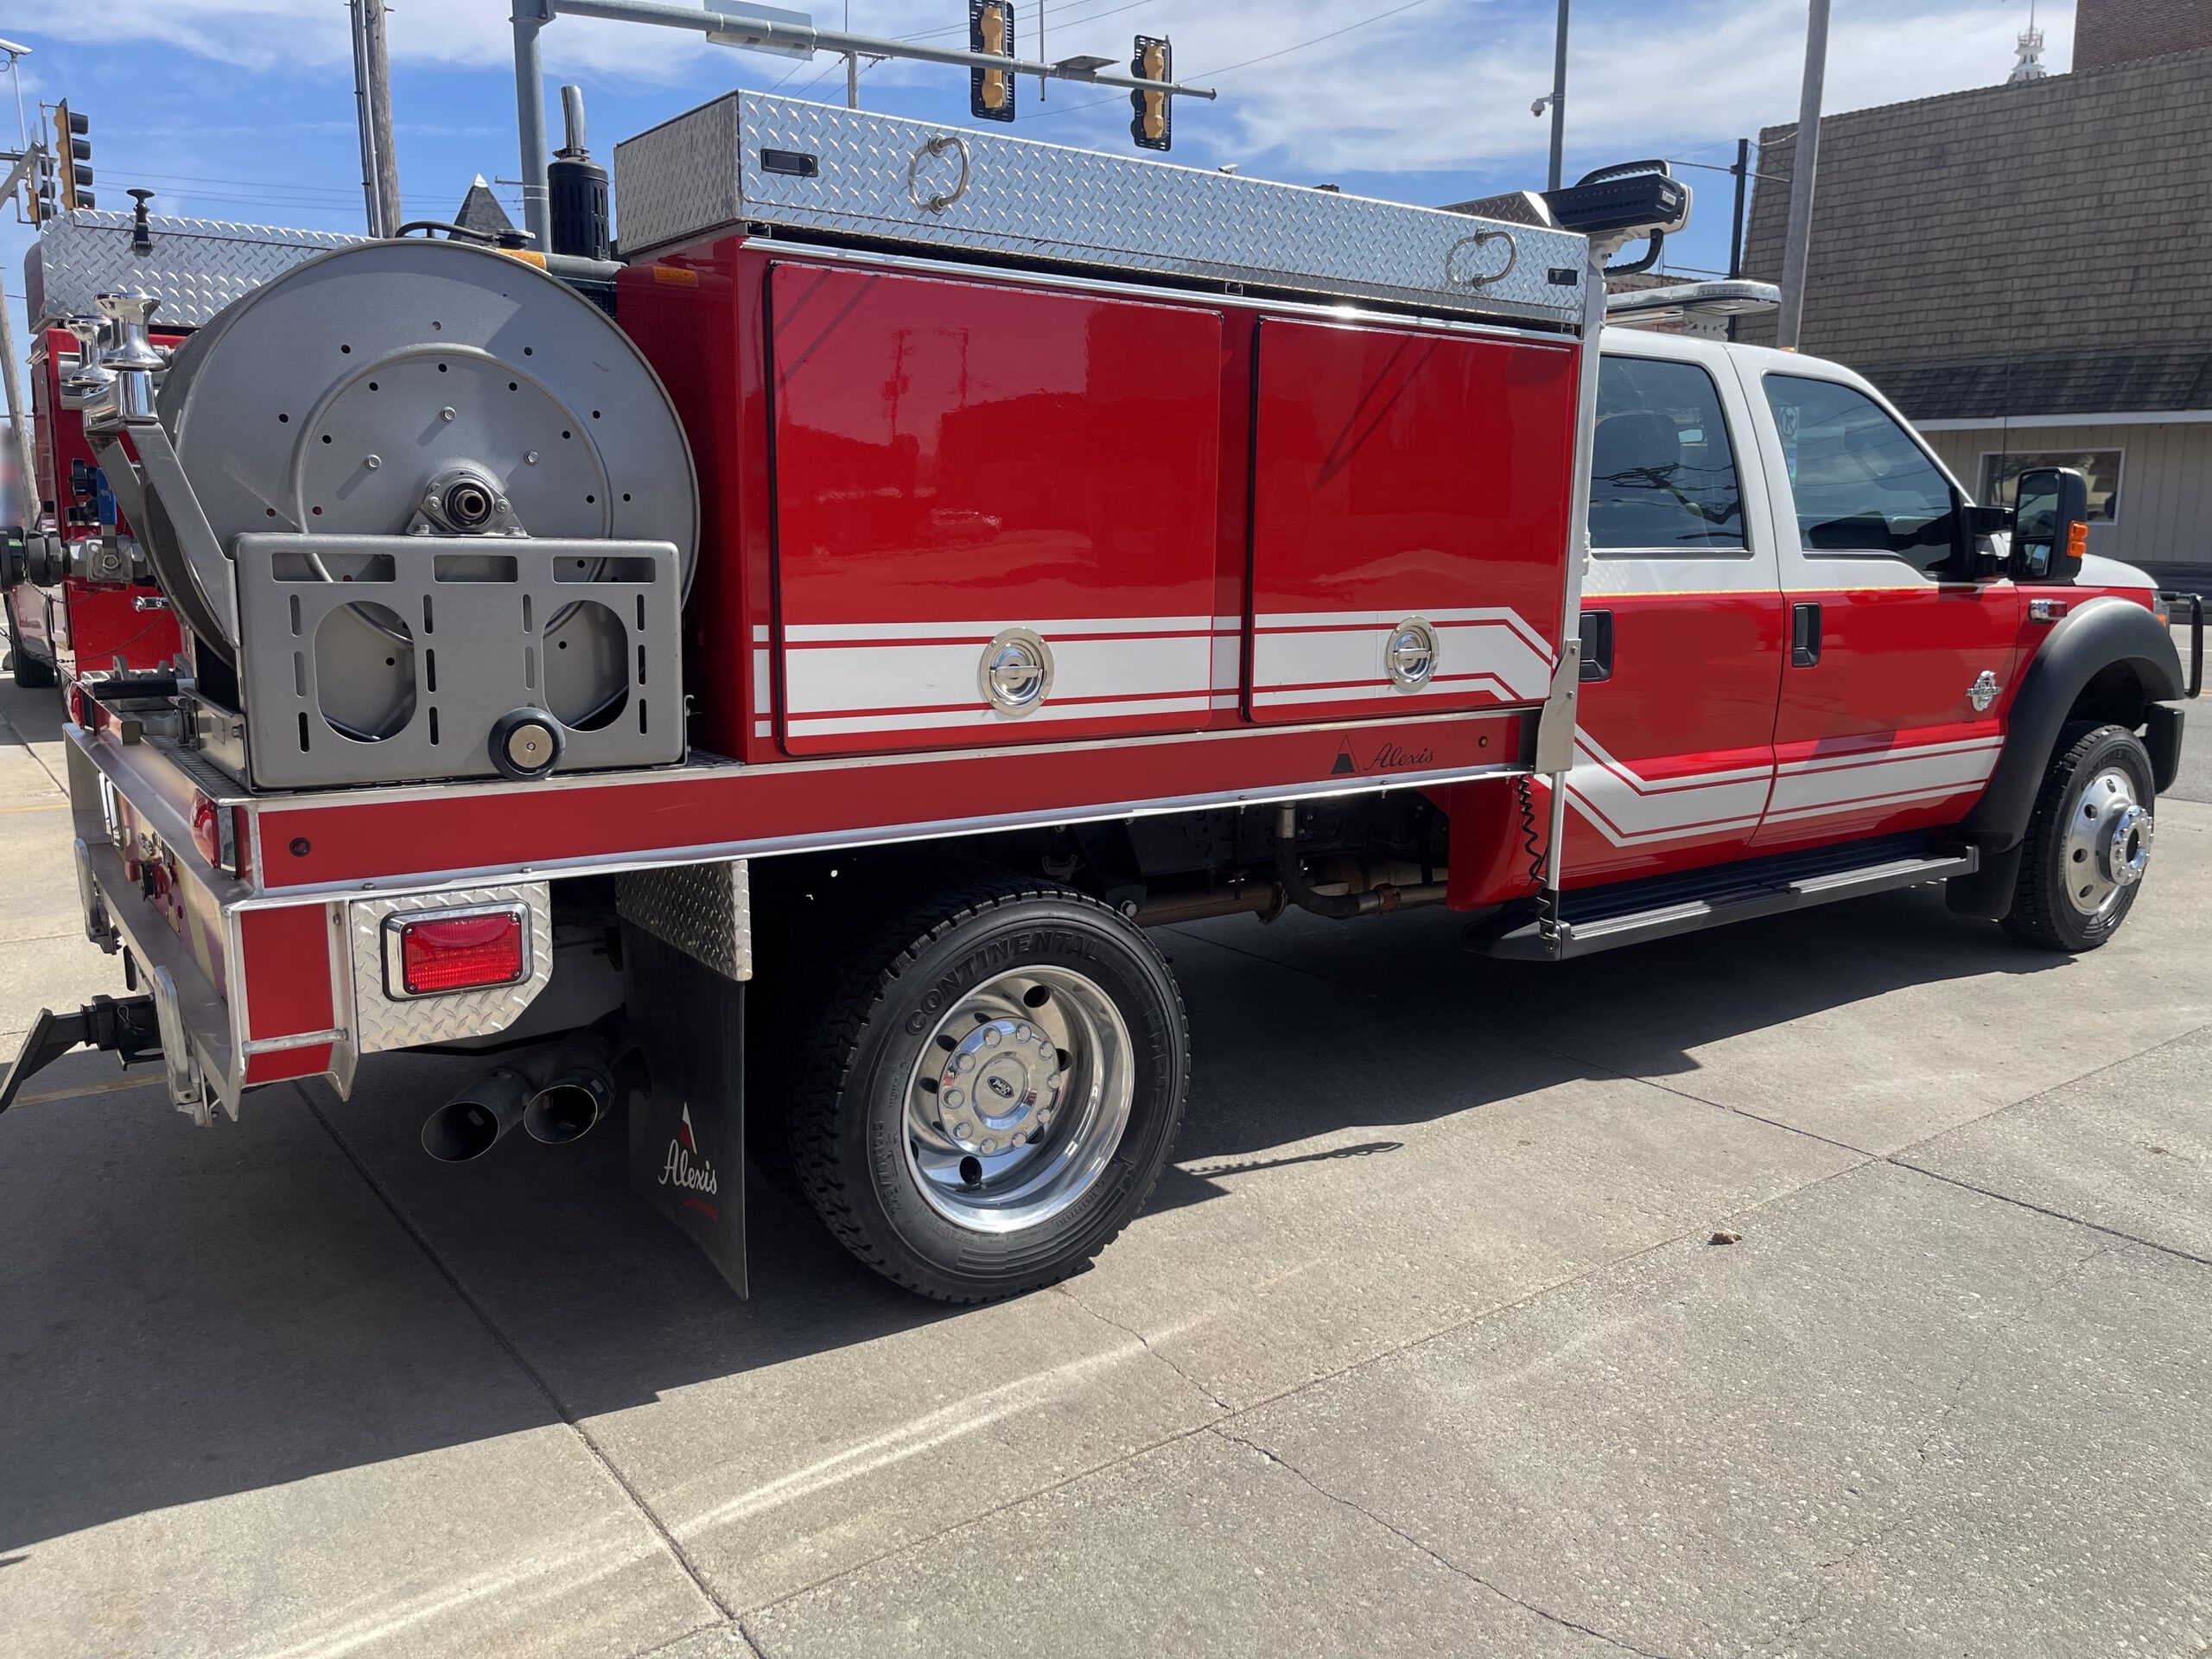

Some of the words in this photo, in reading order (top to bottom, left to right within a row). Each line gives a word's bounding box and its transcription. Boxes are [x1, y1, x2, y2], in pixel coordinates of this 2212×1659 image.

[1363, 742, 1434, 771] Alexis
[905, 930, 1098, 1035] CONTINENTAL
[658, 1139, 717, 1195] Alexis
